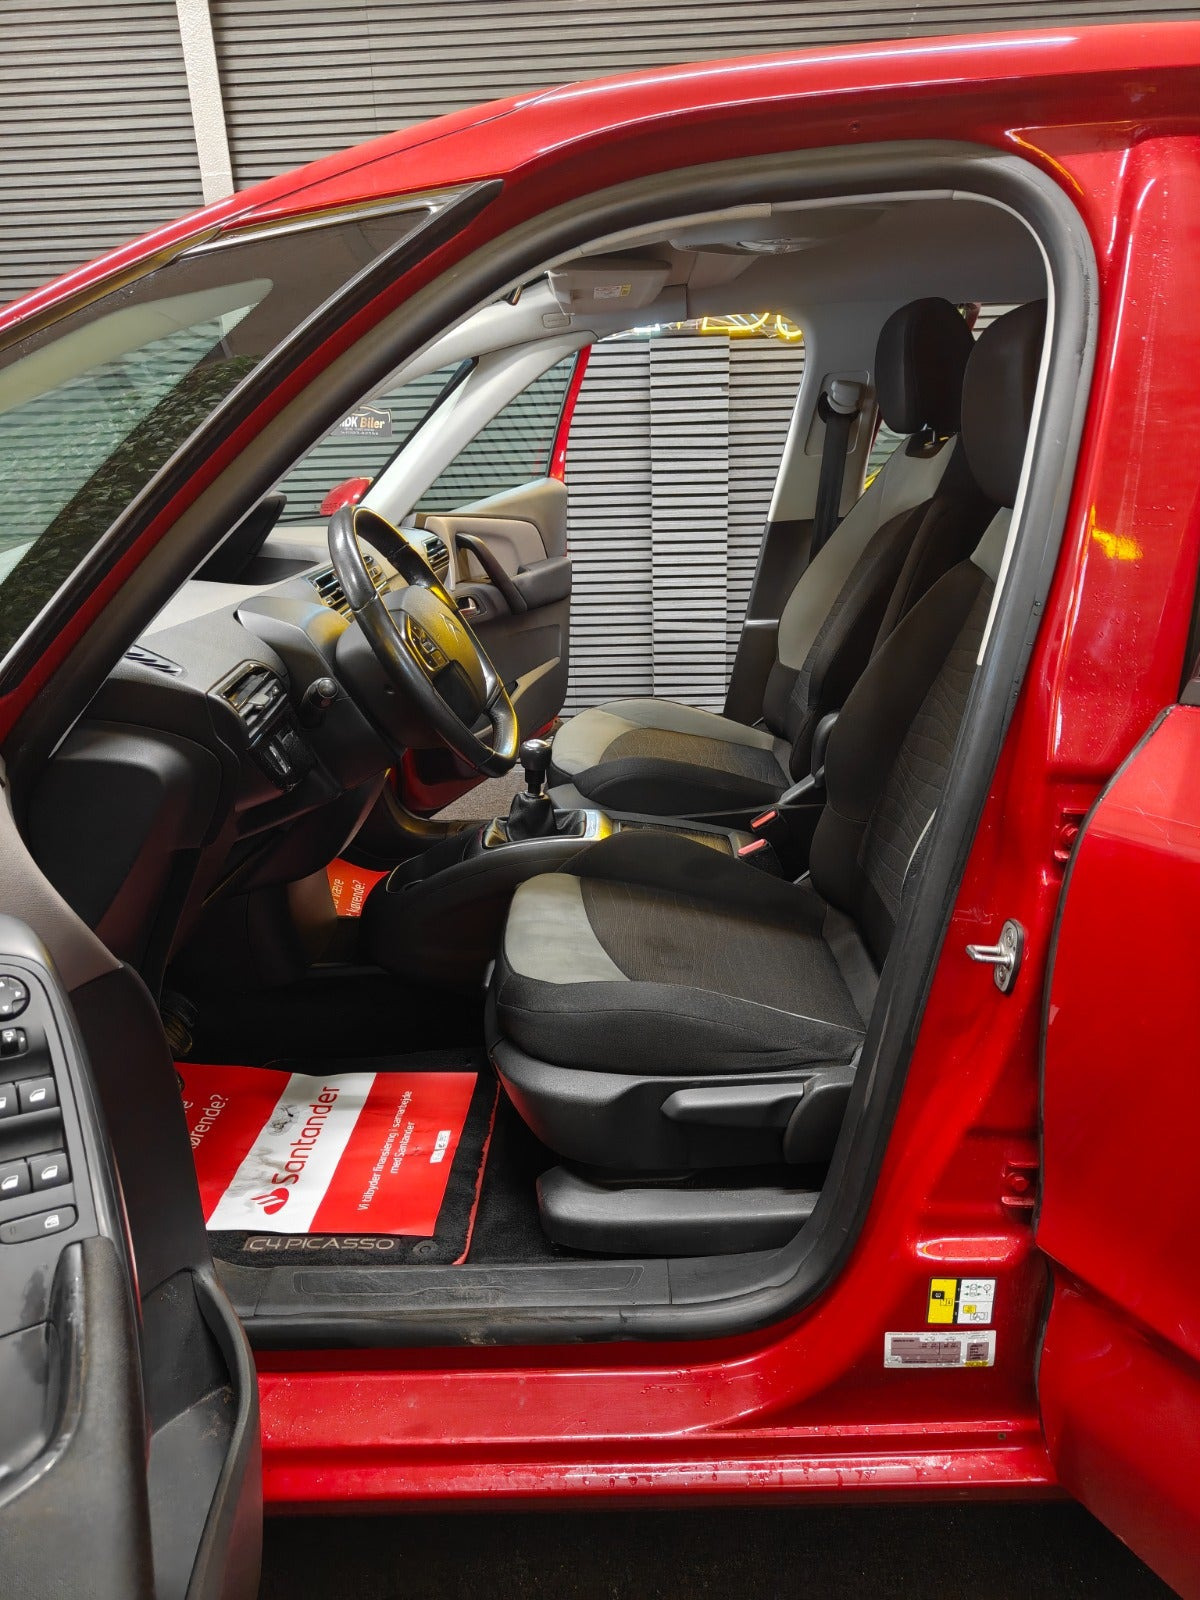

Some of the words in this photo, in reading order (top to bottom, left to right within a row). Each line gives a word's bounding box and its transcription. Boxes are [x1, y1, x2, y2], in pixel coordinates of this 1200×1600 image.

[360, 416, 385, 429] Biler
[271, 1086, 340, 1185] Santander
[394, 1121, 416, 1157] Santander
[373, 1131, 399, 1172] finansiering
[390, 1153, 403, 1174] med
[362, 1172, 381, 1202] tilbyder
[357, 1203, 370, 1211] Vi
[249, 1238, 280, 1250] C4
[285, 1237, 395, 1250] PICASSO
